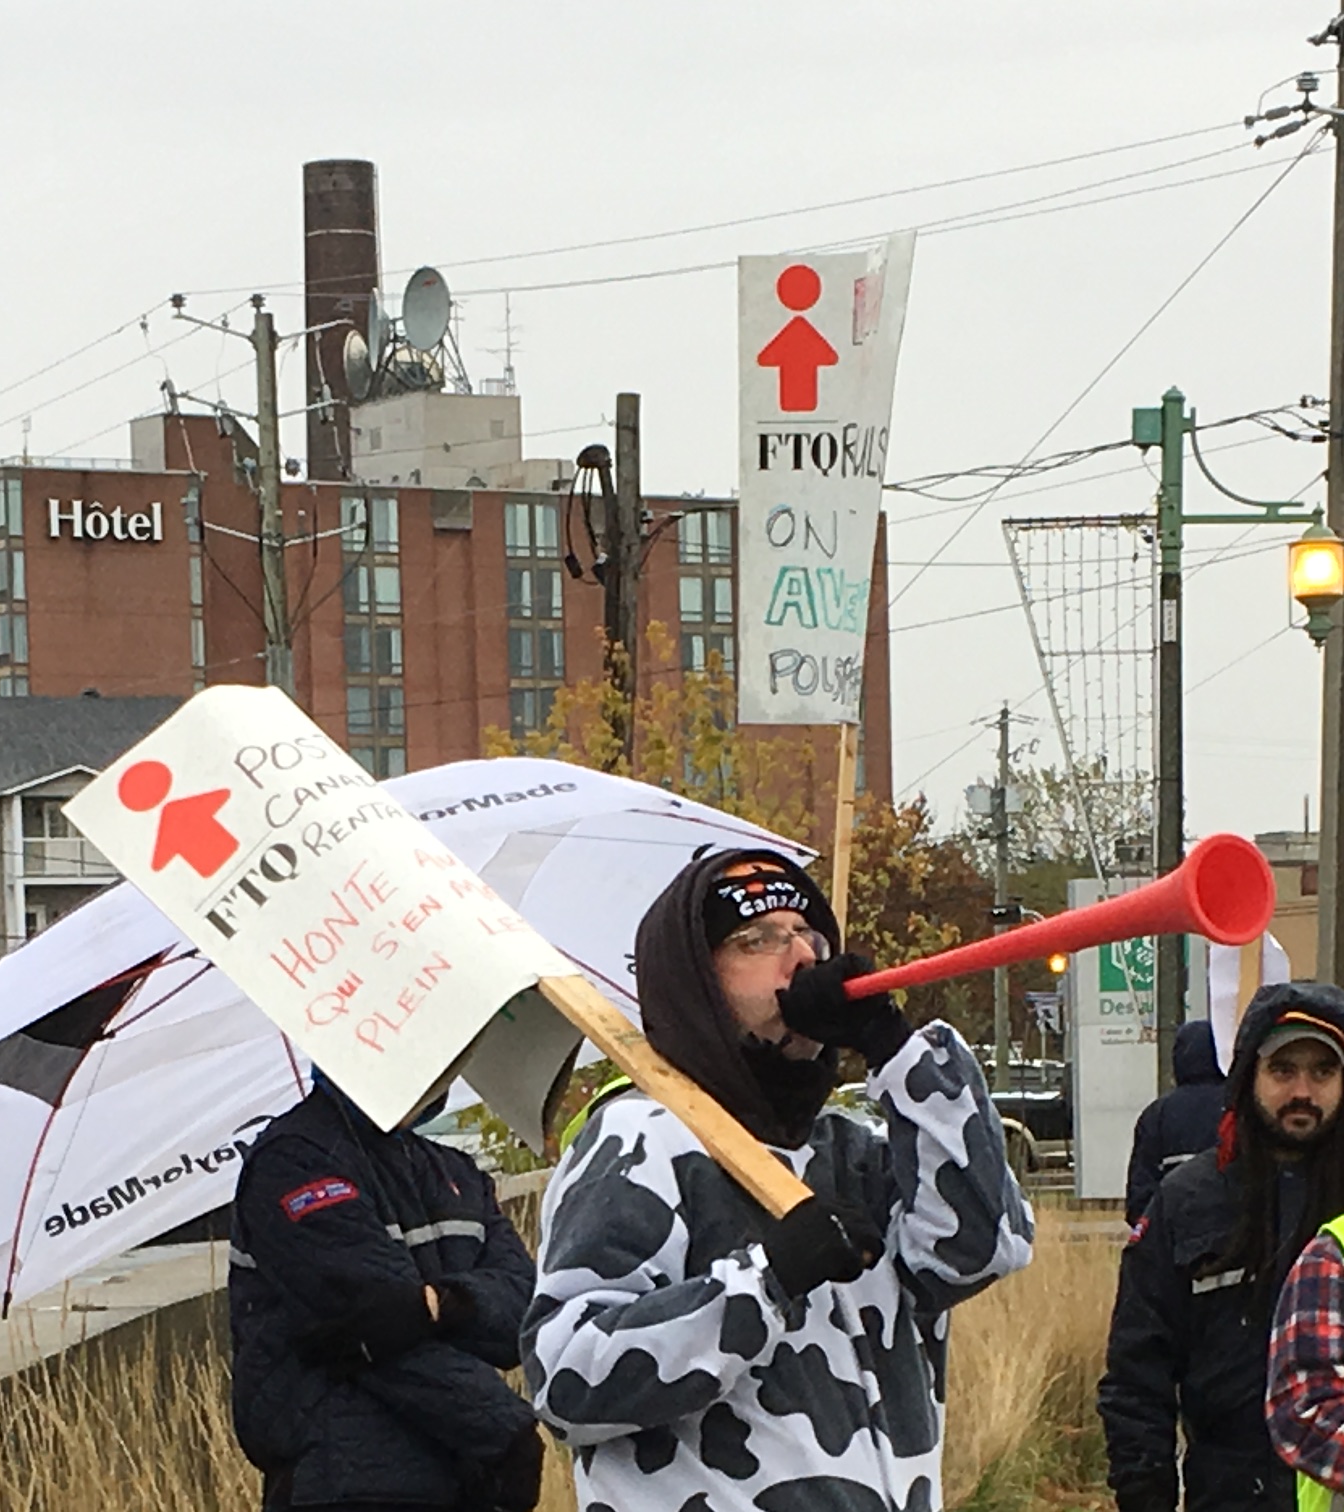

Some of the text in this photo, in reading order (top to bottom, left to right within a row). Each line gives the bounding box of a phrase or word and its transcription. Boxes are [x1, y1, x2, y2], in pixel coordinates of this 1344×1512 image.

[757, 432, 838, 476] FTQ
[48, 497, 164, 541] Hôtel
[204, 843, 300, 941] FTQ
[270, 859, 400, 990] HONTE
[371, 894, 444, 960] S'EN
[355, 952, 453, 1054] PLEIN
